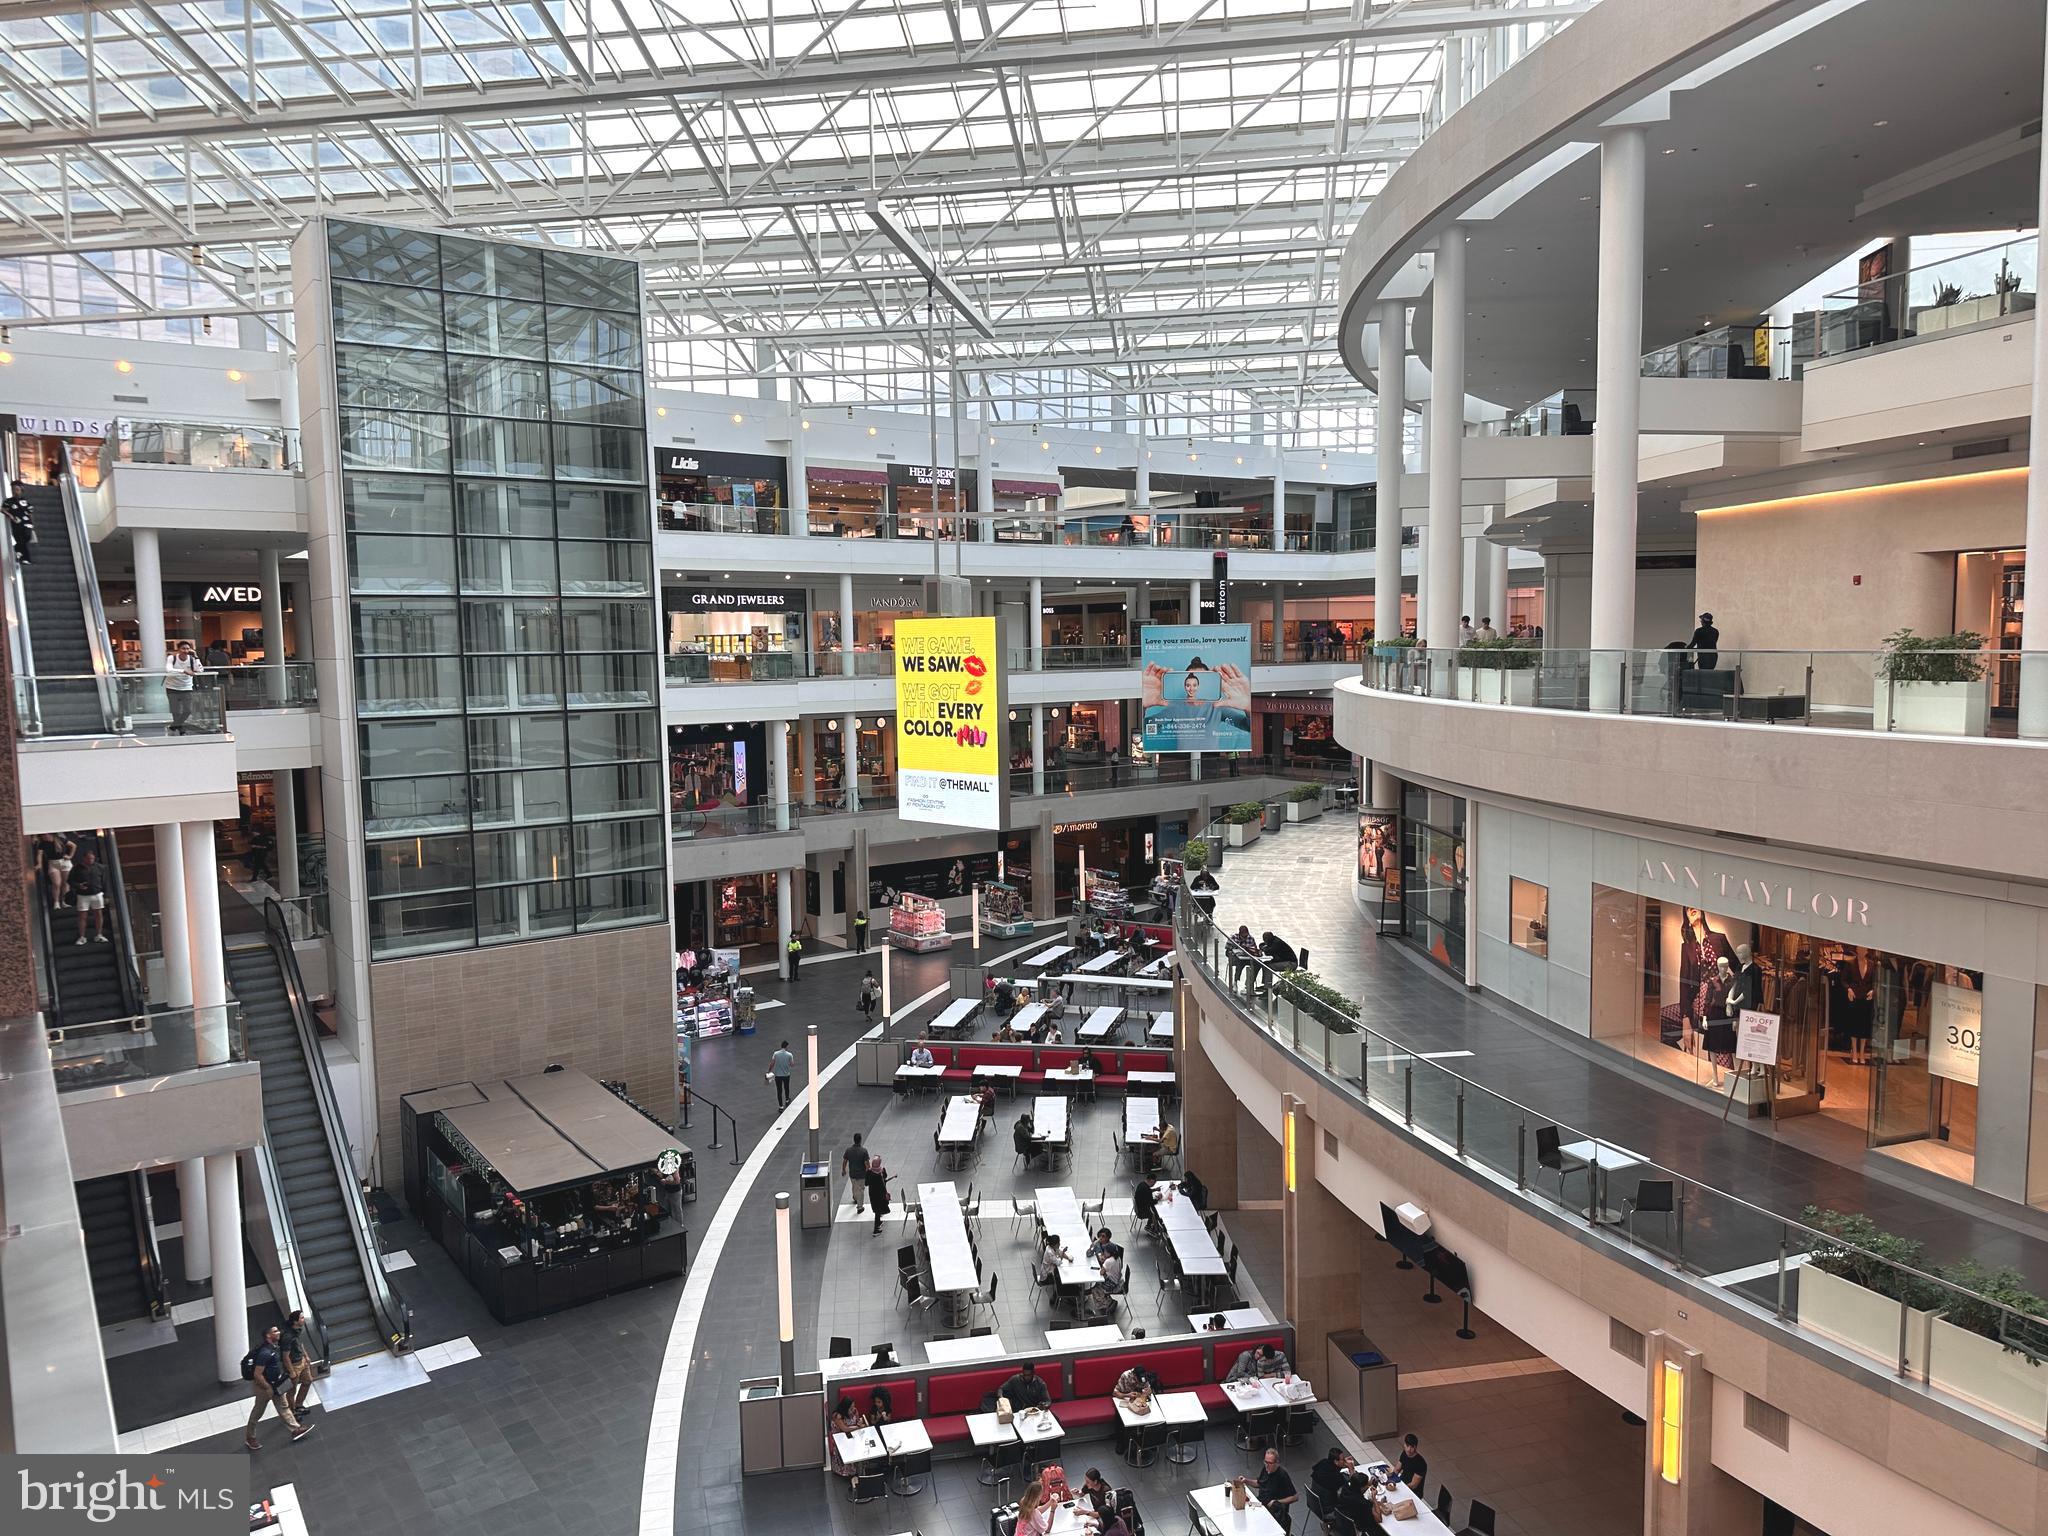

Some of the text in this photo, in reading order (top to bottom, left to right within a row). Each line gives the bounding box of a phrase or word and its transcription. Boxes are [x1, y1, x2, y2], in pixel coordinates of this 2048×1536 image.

[671, 456, 699, 470] Lids
[917, 476, 951, 485] DIAMNDS
[203, 587, 262, 602] AVED
[692, 594, 784, 606] GRAND JEWELERS
[1217, 580, 1226, 625] rdstrom
[901, 637, 975, 655] WE CAME.
[1163, 638, 1178, 646] your
[1217, 636, 1248, 645] yourself.
[902, 656, 964, 672] WE SAW.
[902, 683, 960, 701] WE GOT
[903, 701, 984, 720] IT IN EVERY
[903, 719, 957, 738] COLOR.
[1637, 858, 1873, 927] ANN TAYLOR
[1759, 1017, 1775, 1026] OFF
